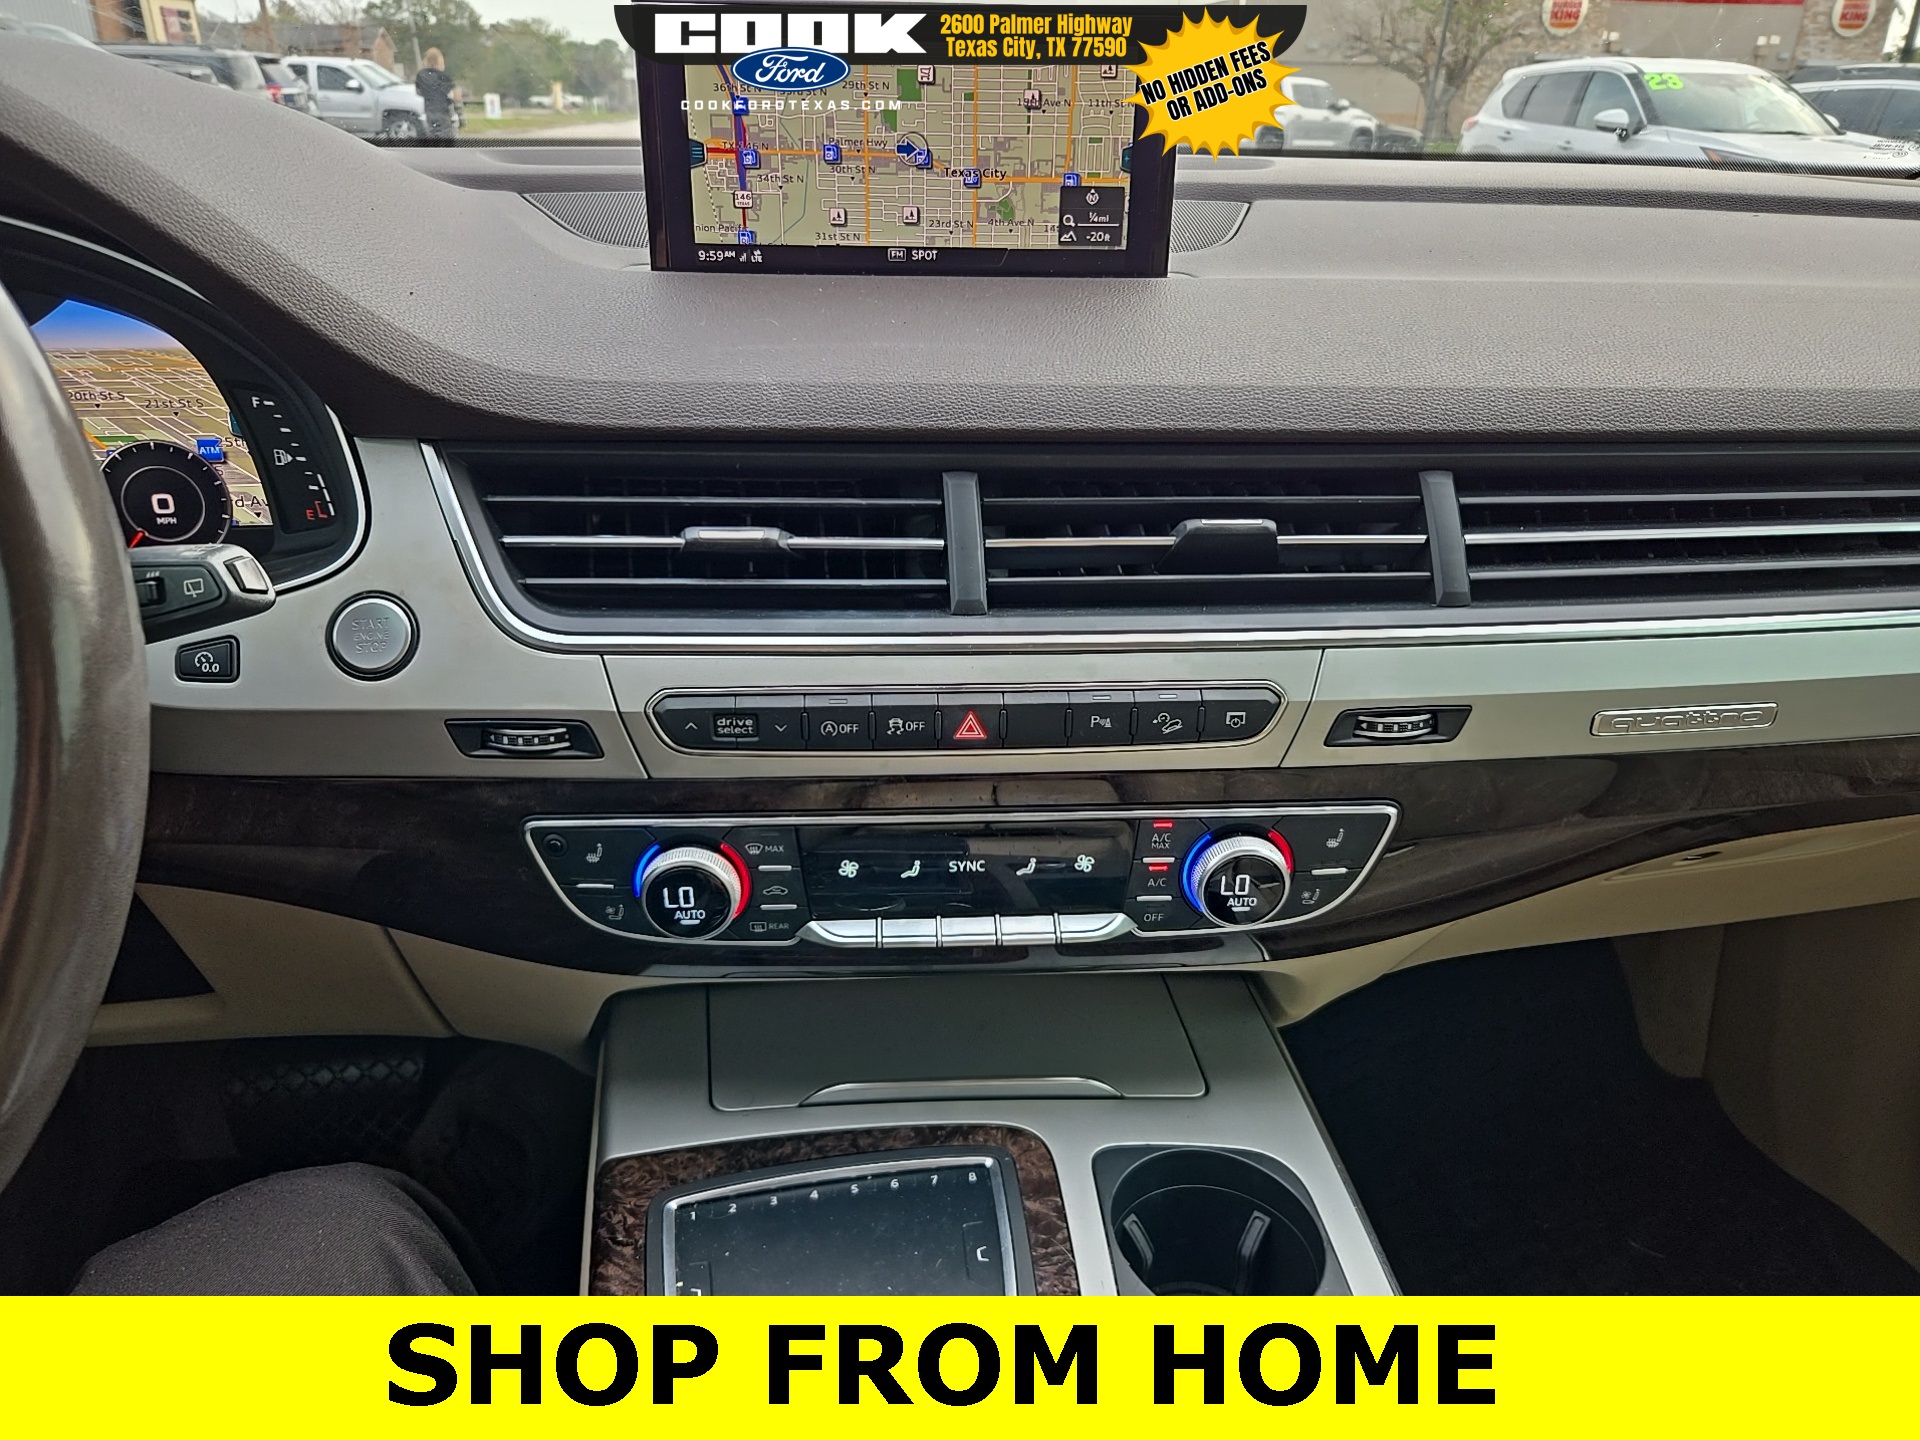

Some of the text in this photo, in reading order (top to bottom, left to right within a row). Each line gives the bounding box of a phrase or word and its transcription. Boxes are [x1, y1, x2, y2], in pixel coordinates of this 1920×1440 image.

[1550, 9, 1581, 21] KING
[713, 82, 738, 92] 36th
[753, 84, 762, 93] N
[842, 80, 890, 90] 29th St N
[1043, 98, 1061, 107] Ave
[1064, 99, 1071, 107] N
[1088, 98, 1111, 107] 11th
[761, 142, 769, 150] N
[828, 137, 888, 149] Palmer Hwy
[830, 165, 852, 174] 30th
[868, 166, 876, 174] N
[944, 167, 1007, 180] Texas City
[756, 174, 804, 183] 34th St N
[735, 193, 752, 201] 146
[929, 219, 974, 228] 23rd St N
[988, 218, 1004, 226] 4th
[1007, 219, 1025, 227] Ave
[815, 232, 861, 241] 31st St N
[891, 250, 938, 261] FM SPOT
[68, 391, 126, 400] 20th St S
[145, 398, 204, 408] 21st St S
[251, 396, 260, 408] F
[200, 446, 221, 454] ATM
[306, 509, 316, 520] E
[156, 516, 177, 525] MPH
[351, 617, 390, 630] START
[354, 631, 390, 641] ENGINE
[355, 641, 387, 654] STOP
[201, 662, 220, 673] 0.0
[717, 716, 753, 727] drive
[905, 721, 925, 732] OFF
[1611, 710, 1764, 733] quattro
[717, 724, 754, 734] select
[1152, 832, 1171, 843] A/C
[948, 860, 986, 872] SYNC
[1147, 877, 1167, 887] A/C
[1227, 897, 1257, 907] AUTO
[674, 909, 706, 920] AUTO
[1144, 913, 1164, 922] OFF
[768, 922, 789, 930] REAR
[930, 1175, 938, 1185] 7
[968, 1171, 977, 1182] 8
[891, 1178, 899, 1189] 6
[850, 1184, 859, 1194] 5
[810, 1190, 819, 1199] 4
[770, 1196, 778, 1206] 3
[728, 1204, 737, 1213] 2
[690, 1211, 696, 1221] 1
